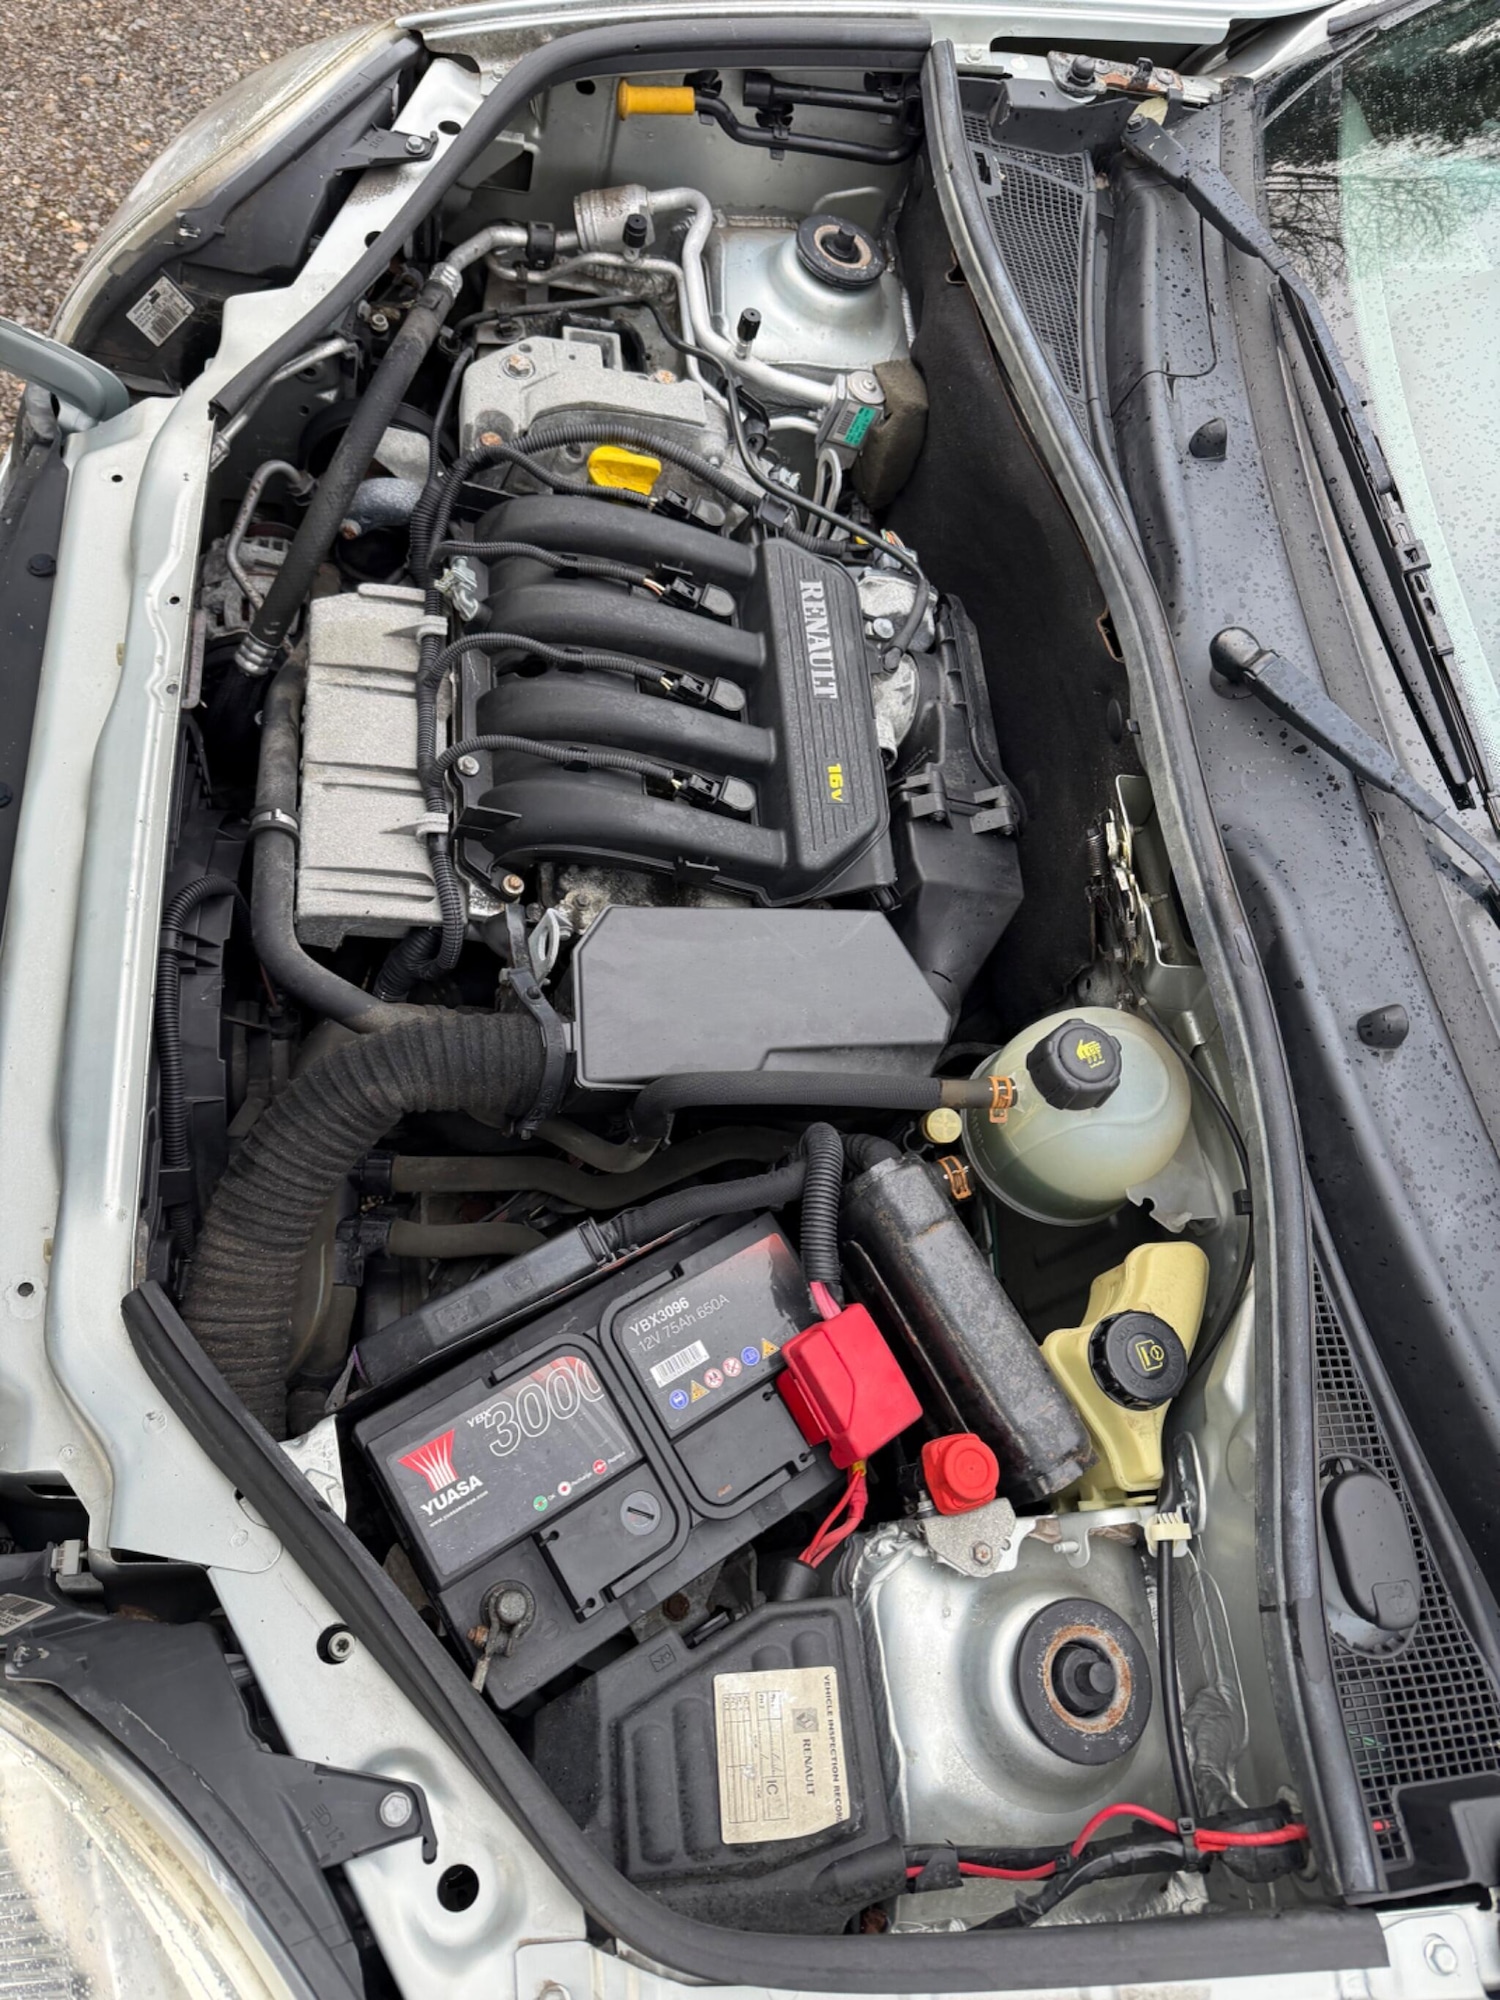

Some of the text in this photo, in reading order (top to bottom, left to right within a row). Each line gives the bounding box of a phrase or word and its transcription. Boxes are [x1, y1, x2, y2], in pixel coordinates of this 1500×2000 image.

[800, 580, 838, 699] RENAULT
[629, 1296, 690, 1337] YBX3096
[637, 1294, 730, 1352] 12V 75Ah 650A
[466, 1409, 492, 1429] YBX
[420, 1475, 484, 1518] YUASA
[823, 1674, 833, 1717] VEHICLE
[802, 1738, 815, 1797] RENAULT
[827, 1719, 840, 1783] INSPECTION
[766, 1779, 779, 1796] IC
